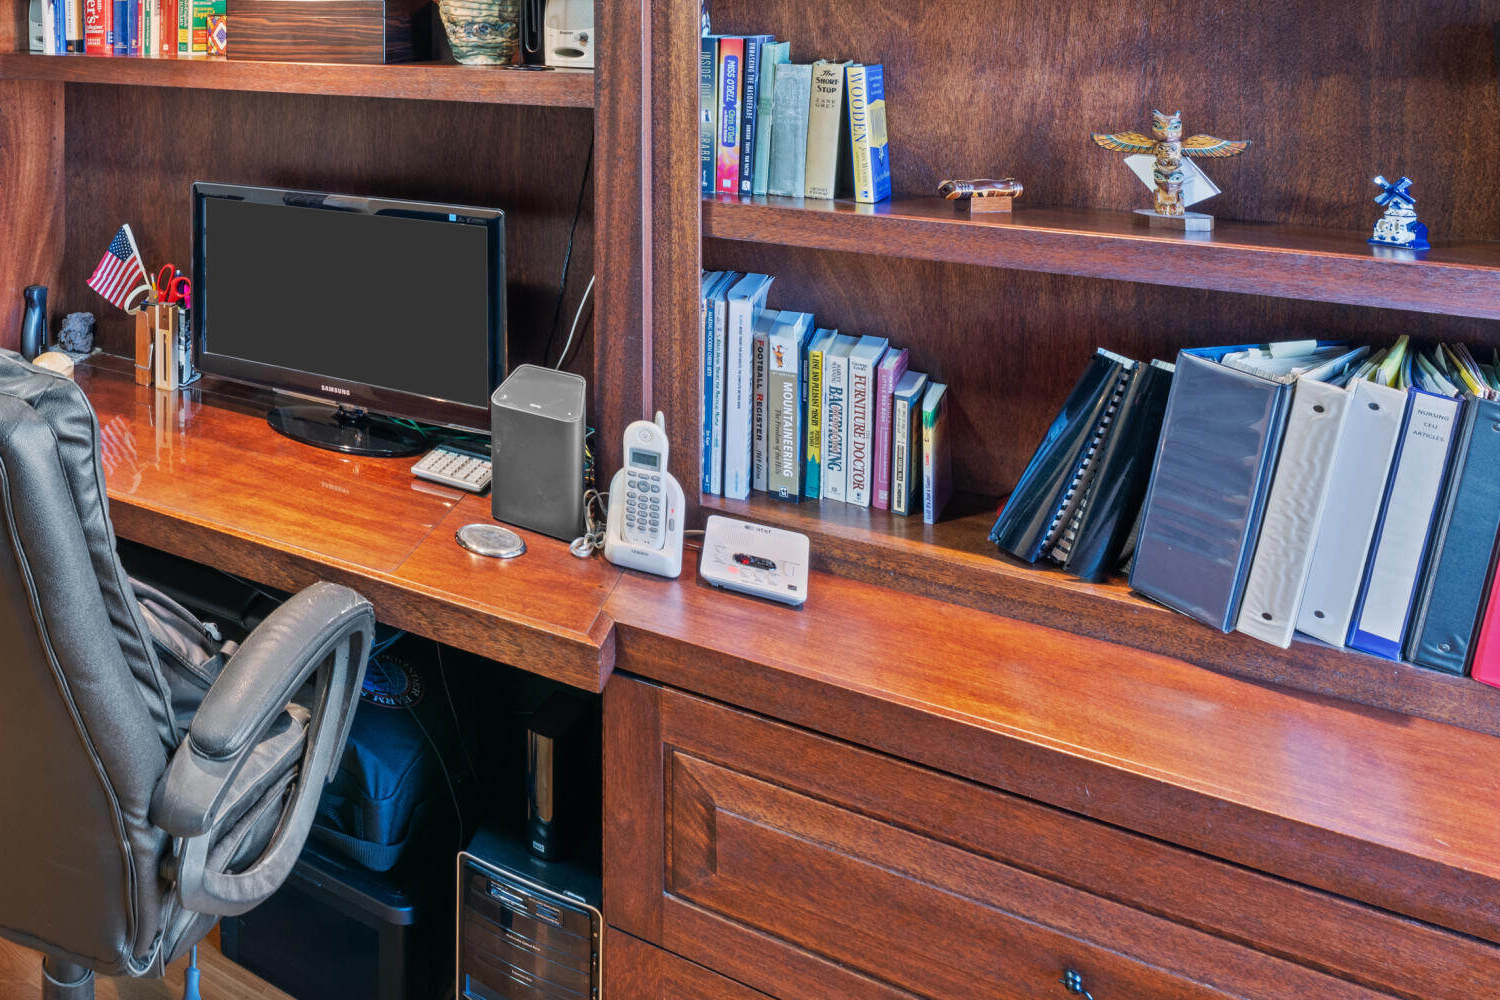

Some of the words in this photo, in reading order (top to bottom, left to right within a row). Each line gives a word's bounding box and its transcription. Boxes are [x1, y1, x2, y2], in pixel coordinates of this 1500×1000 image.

[747, 42, 757, 73] UNMASKING
[726, 59, 736, 78] MISS
[820, 69, 836, 77] The
[746, 74, 754, 85] THE
[815, 77, 839, 86] SHORT
[725, 79, 736, 103] O'DELL
[816, 85, 837, 94] STOP
[849, 72, 867, 143] WOODEN
[728, 109, 736, 124] Chris
[756, 340, 764, 389] FOOTBALL
[320, 384, 351, 396] SAMSUNG
[774, 409, 782, 419] The
[853, 373, 867, 438] FURNITURE
[755, 393, 764, 441] REGISTER
[1417, 408, 1450, 422] NURSING
[782, 381, 793, 478] MOUNTAINEERING
[827, 386, 844, 472] BACKPACKING
[1423, 421, 1439, 431] CEU
[1412, 429, 1445, 443] ARTICLES
[852, 441, 866, 490] DOCTOR
